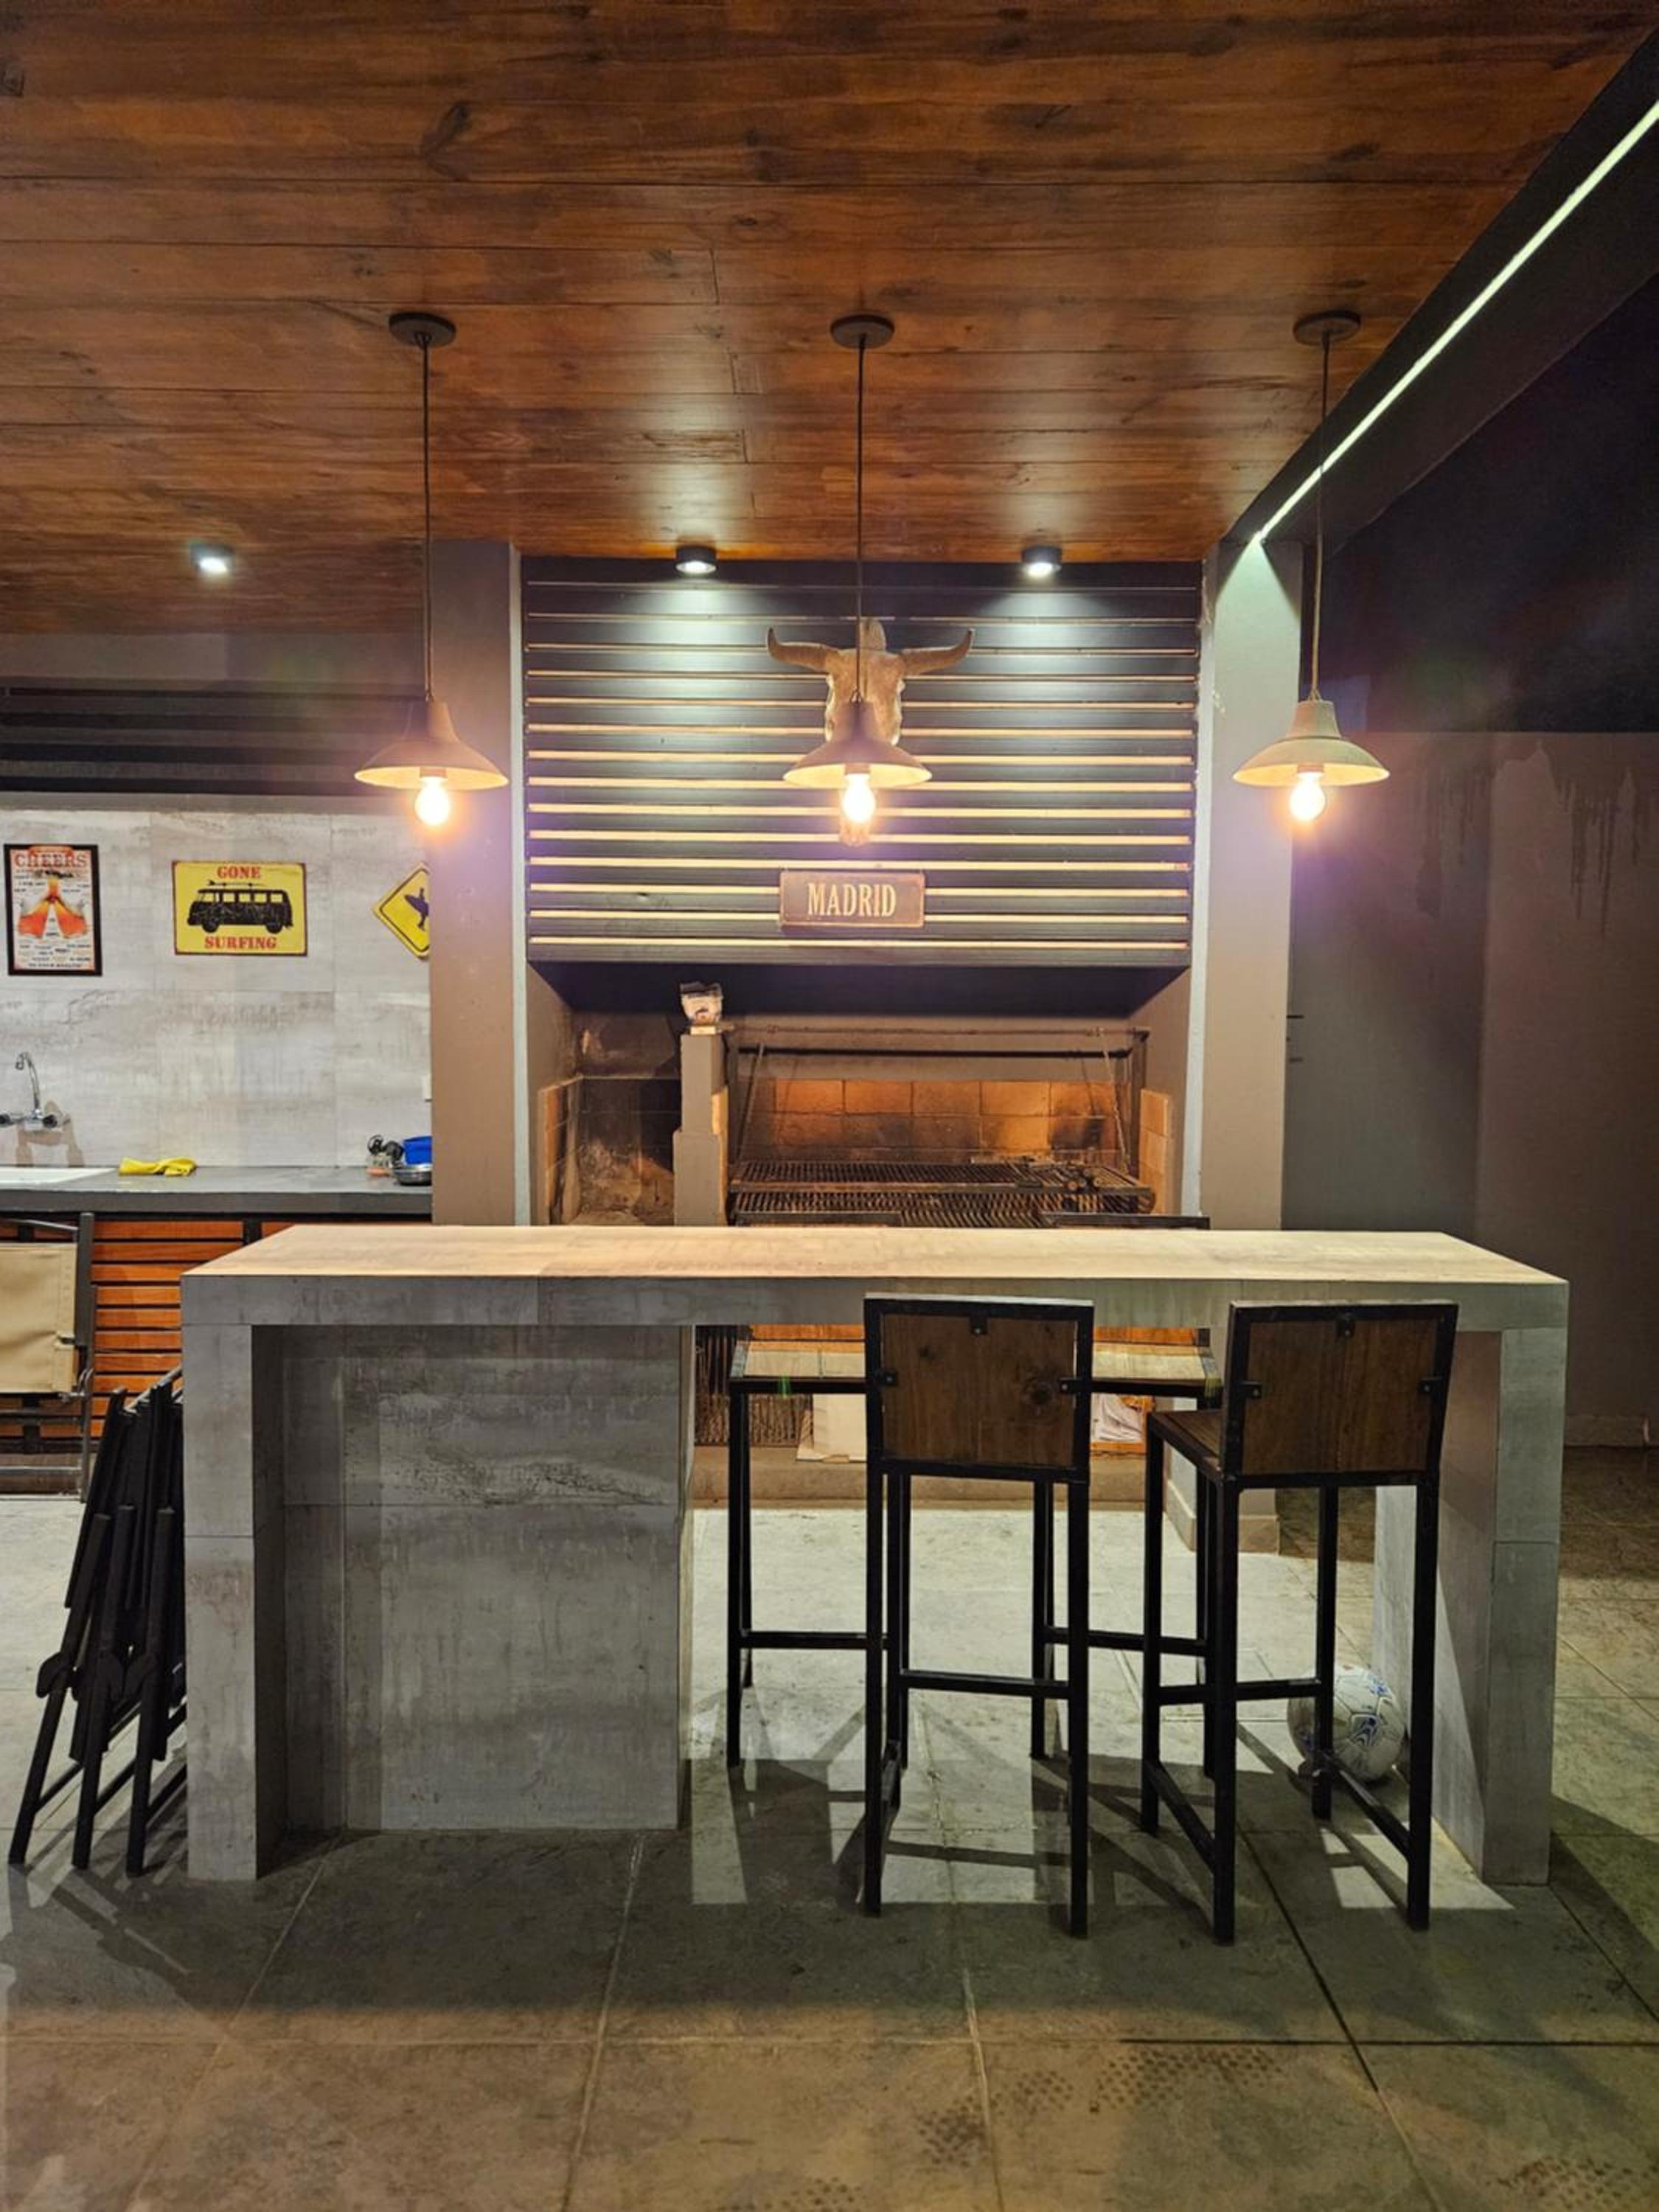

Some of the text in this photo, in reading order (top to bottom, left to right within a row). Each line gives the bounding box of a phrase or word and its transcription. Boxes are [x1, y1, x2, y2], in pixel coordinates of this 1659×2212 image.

[15, 853, 88, 867] CHEERS
[217, 866, 261, 879] GONE
[807, 883, 897, 917] MADRID
[204, 936, 277, 949] SURFING
